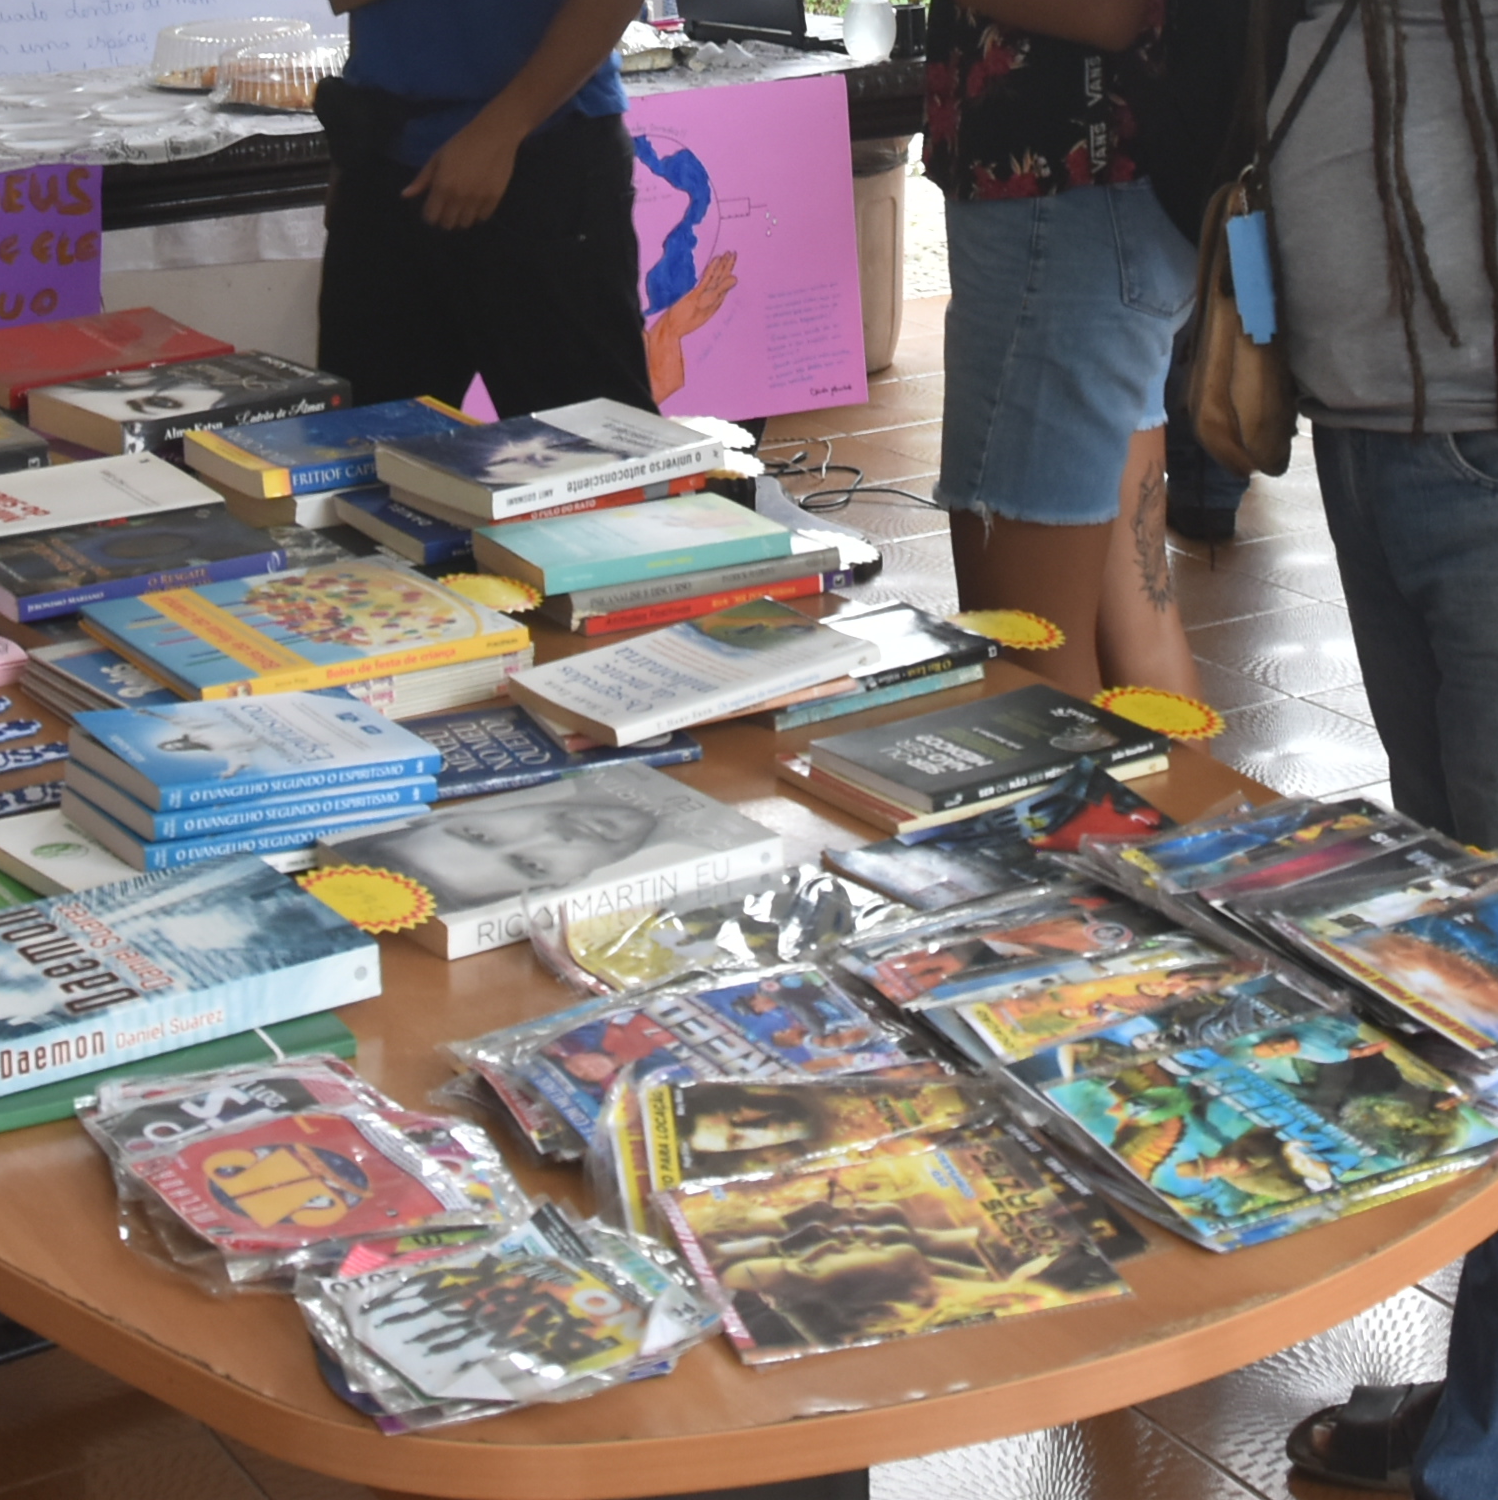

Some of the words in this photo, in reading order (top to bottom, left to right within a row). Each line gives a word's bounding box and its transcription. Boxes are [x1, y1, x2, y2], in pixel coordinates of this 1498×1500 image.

[1084, 55, 1103, 108] VANS
[1089, 121, 1107, 174] VANS
[235, 410, 275, 426] Ladrão
[276, 407, 287, 419] de
[287, 398, 326, 415] Almas
[292, 468, 343, 486] FRITJOF
[566, 461, 647, 493] autoconsciente
[649, 454, 693, 474] universo
[326, 666, 355, 680] Bolos
[358, 663, 372, 674] de
[375, 655, 401, 670] festa
[404, 654, 417, 665] de
[419, 647, 456, 662] criança
[593, 663, 651, 693] mente
[558, 665, 624, 702] segredos
[625, 699, 654, 714] Os
[189, 788, 201, 803] O
[202, 779, 270, 802] EVANGELHO
[270, 771, 325, 793] SEGUNDO
[326, 770, 338, 785] O
[338, 761, 405, 784] ESPIRITISMO
[979, 785, 996, 799] SER
[1009, 776, 1028, 791] NÃO
[184, 817, 196, 832] O
[196, 808, 265, 830] EVANGELHO
[264, 799, 321, 822] SEGUNDO
[321, 797, 334, 813] O
[333, 790, 401, 812] ESPIRITISMO
[175, 846, 187, 861] O
[187, 836, 257, 859] EVANGELHO
[257, 828, 315, 851] SEGUNDO
[571, 870, 678, 922] MARTIN
[695, 857, 731, 890] EU
[55, 902, 117, 958] Suarez
[115, 948, 177, 992] Daniel
[0, 1028, 107, 1082] Daemon
[115, 1018, 167, 1050] Daniel
[168, 1007, 226, 1038] Suarez
[660, 1140, 674, 1172] PARA
